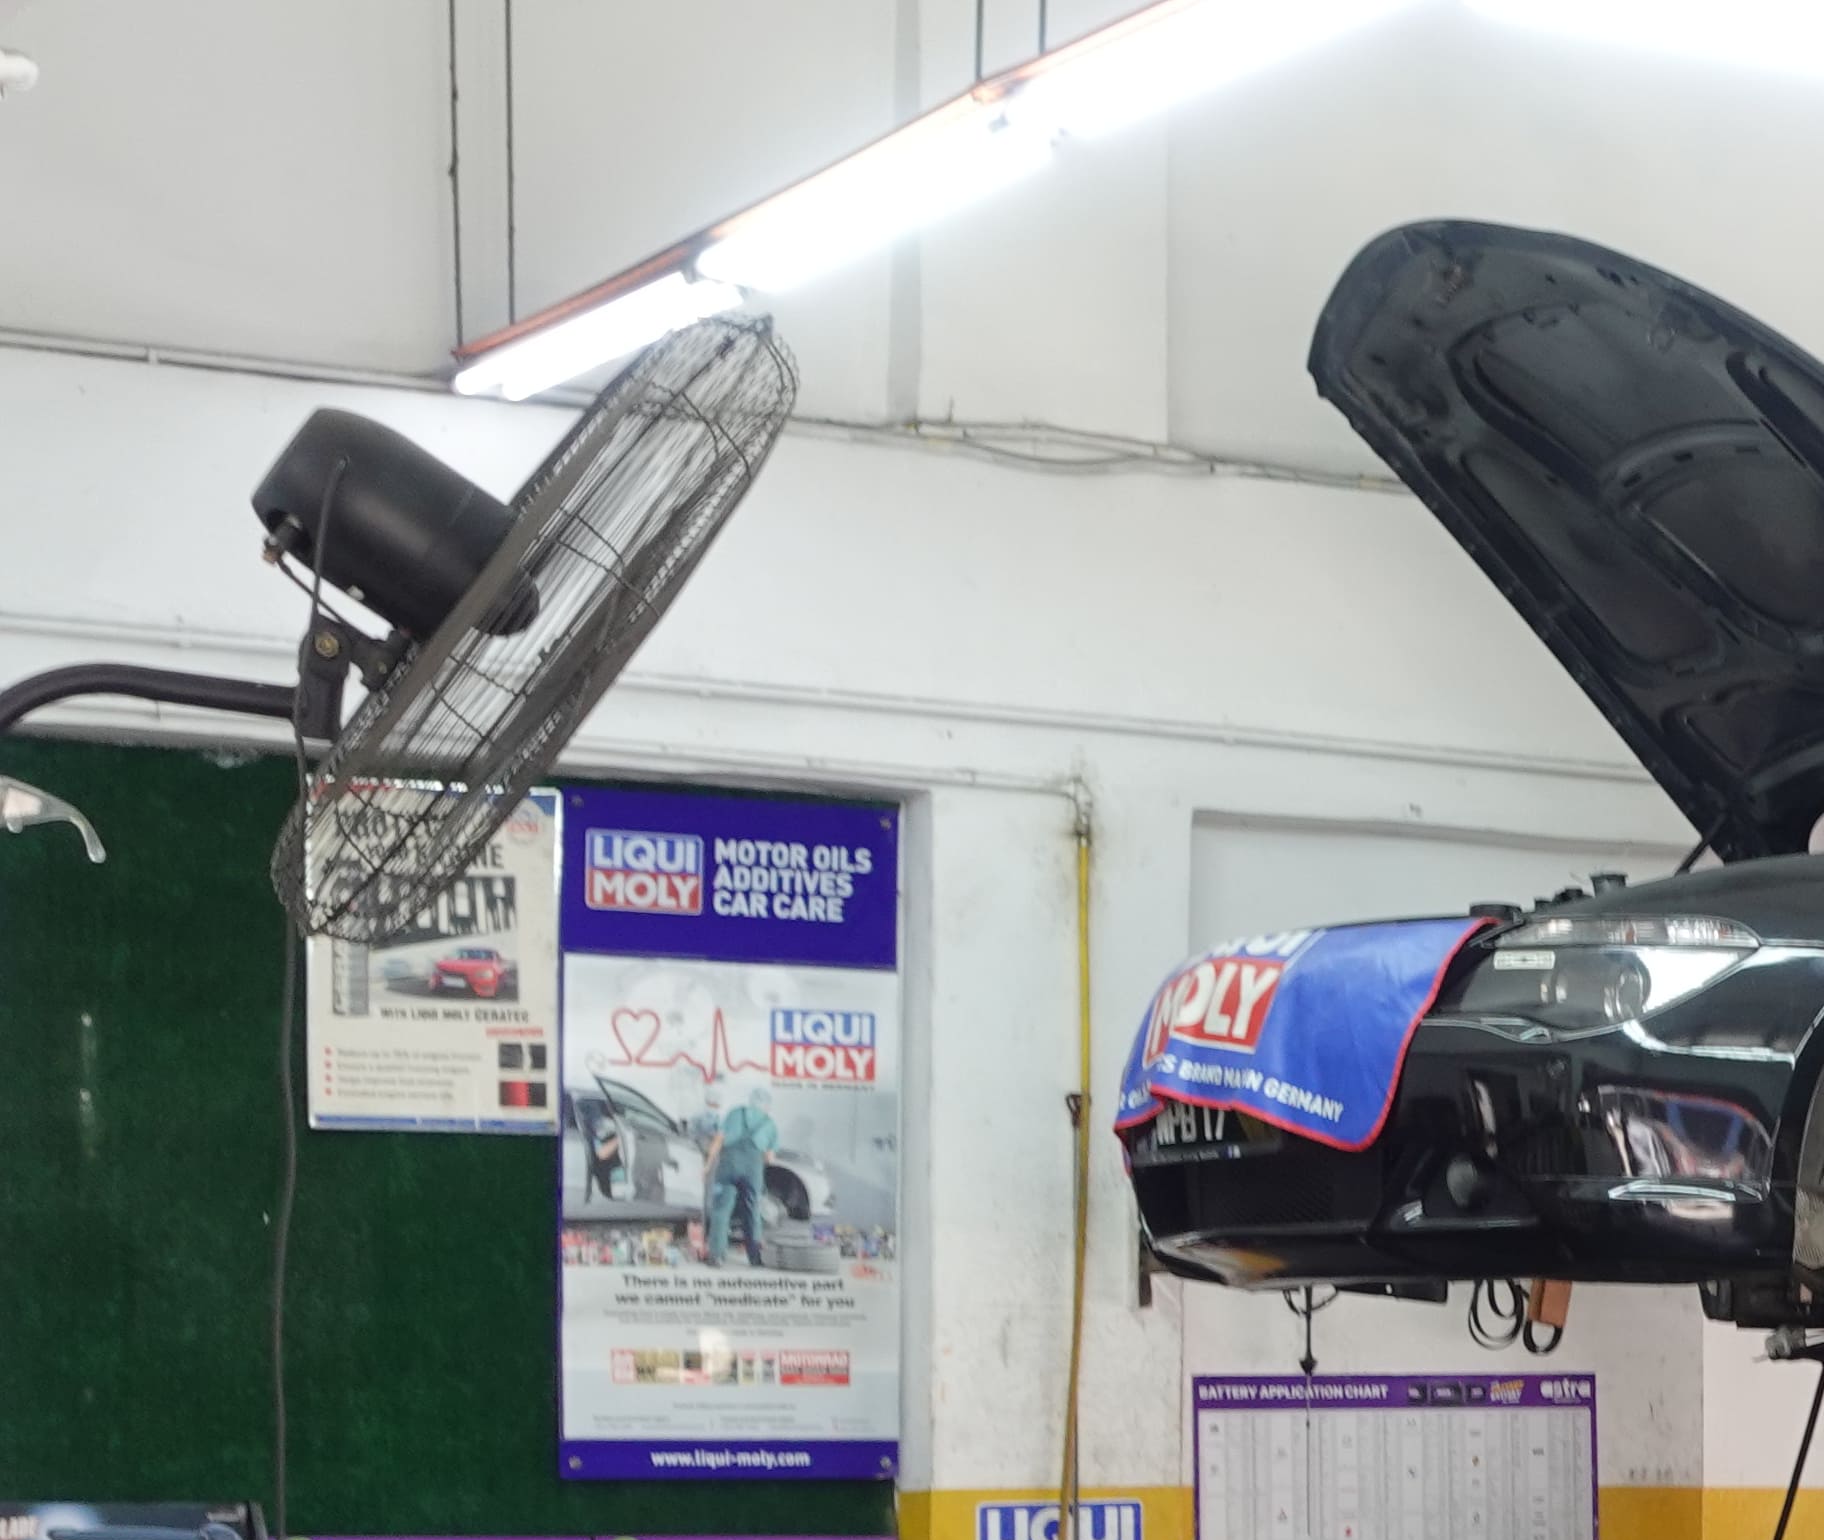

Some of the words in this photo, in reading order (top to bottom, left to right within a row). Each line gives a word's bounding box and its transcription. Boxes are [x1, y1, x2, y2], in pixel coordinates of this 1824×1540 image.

[593, 834, 698, 873] LIQUI
[714, 838, 808, 869] MOTOR
[813, 846, 872, 874] OILS
[593, 871, 698, 909] MOLY
[713, 866, 853, 898] ADDITIVES
[713, 891, 768, 918] CAR
[773, 895, 844, 923] CARE
[1147, 961, 1282, 1058] MOLY
[775, 1011, 871, 1046] LIQUI
[775, 1046, 873, 1080] MOLY
[1263, 1077, 1344, 1123] GERMANY
[622, 1274, 669, 1288] There
[718, 1277, 807, 1290] automotive
[812, 1278, 844, 1292] part
[644, 1294, 700, 1306] cannot
[827, 1298, 855, 1311] you
[1199, 1384, 1257, 1400] BATTERY
[1259, 1384, 1343, 1400] APPLICATION
[1344, 1384, 1389, 1399] CHART
[650, 1448, 811, 1471] www.liqui-moly.com
